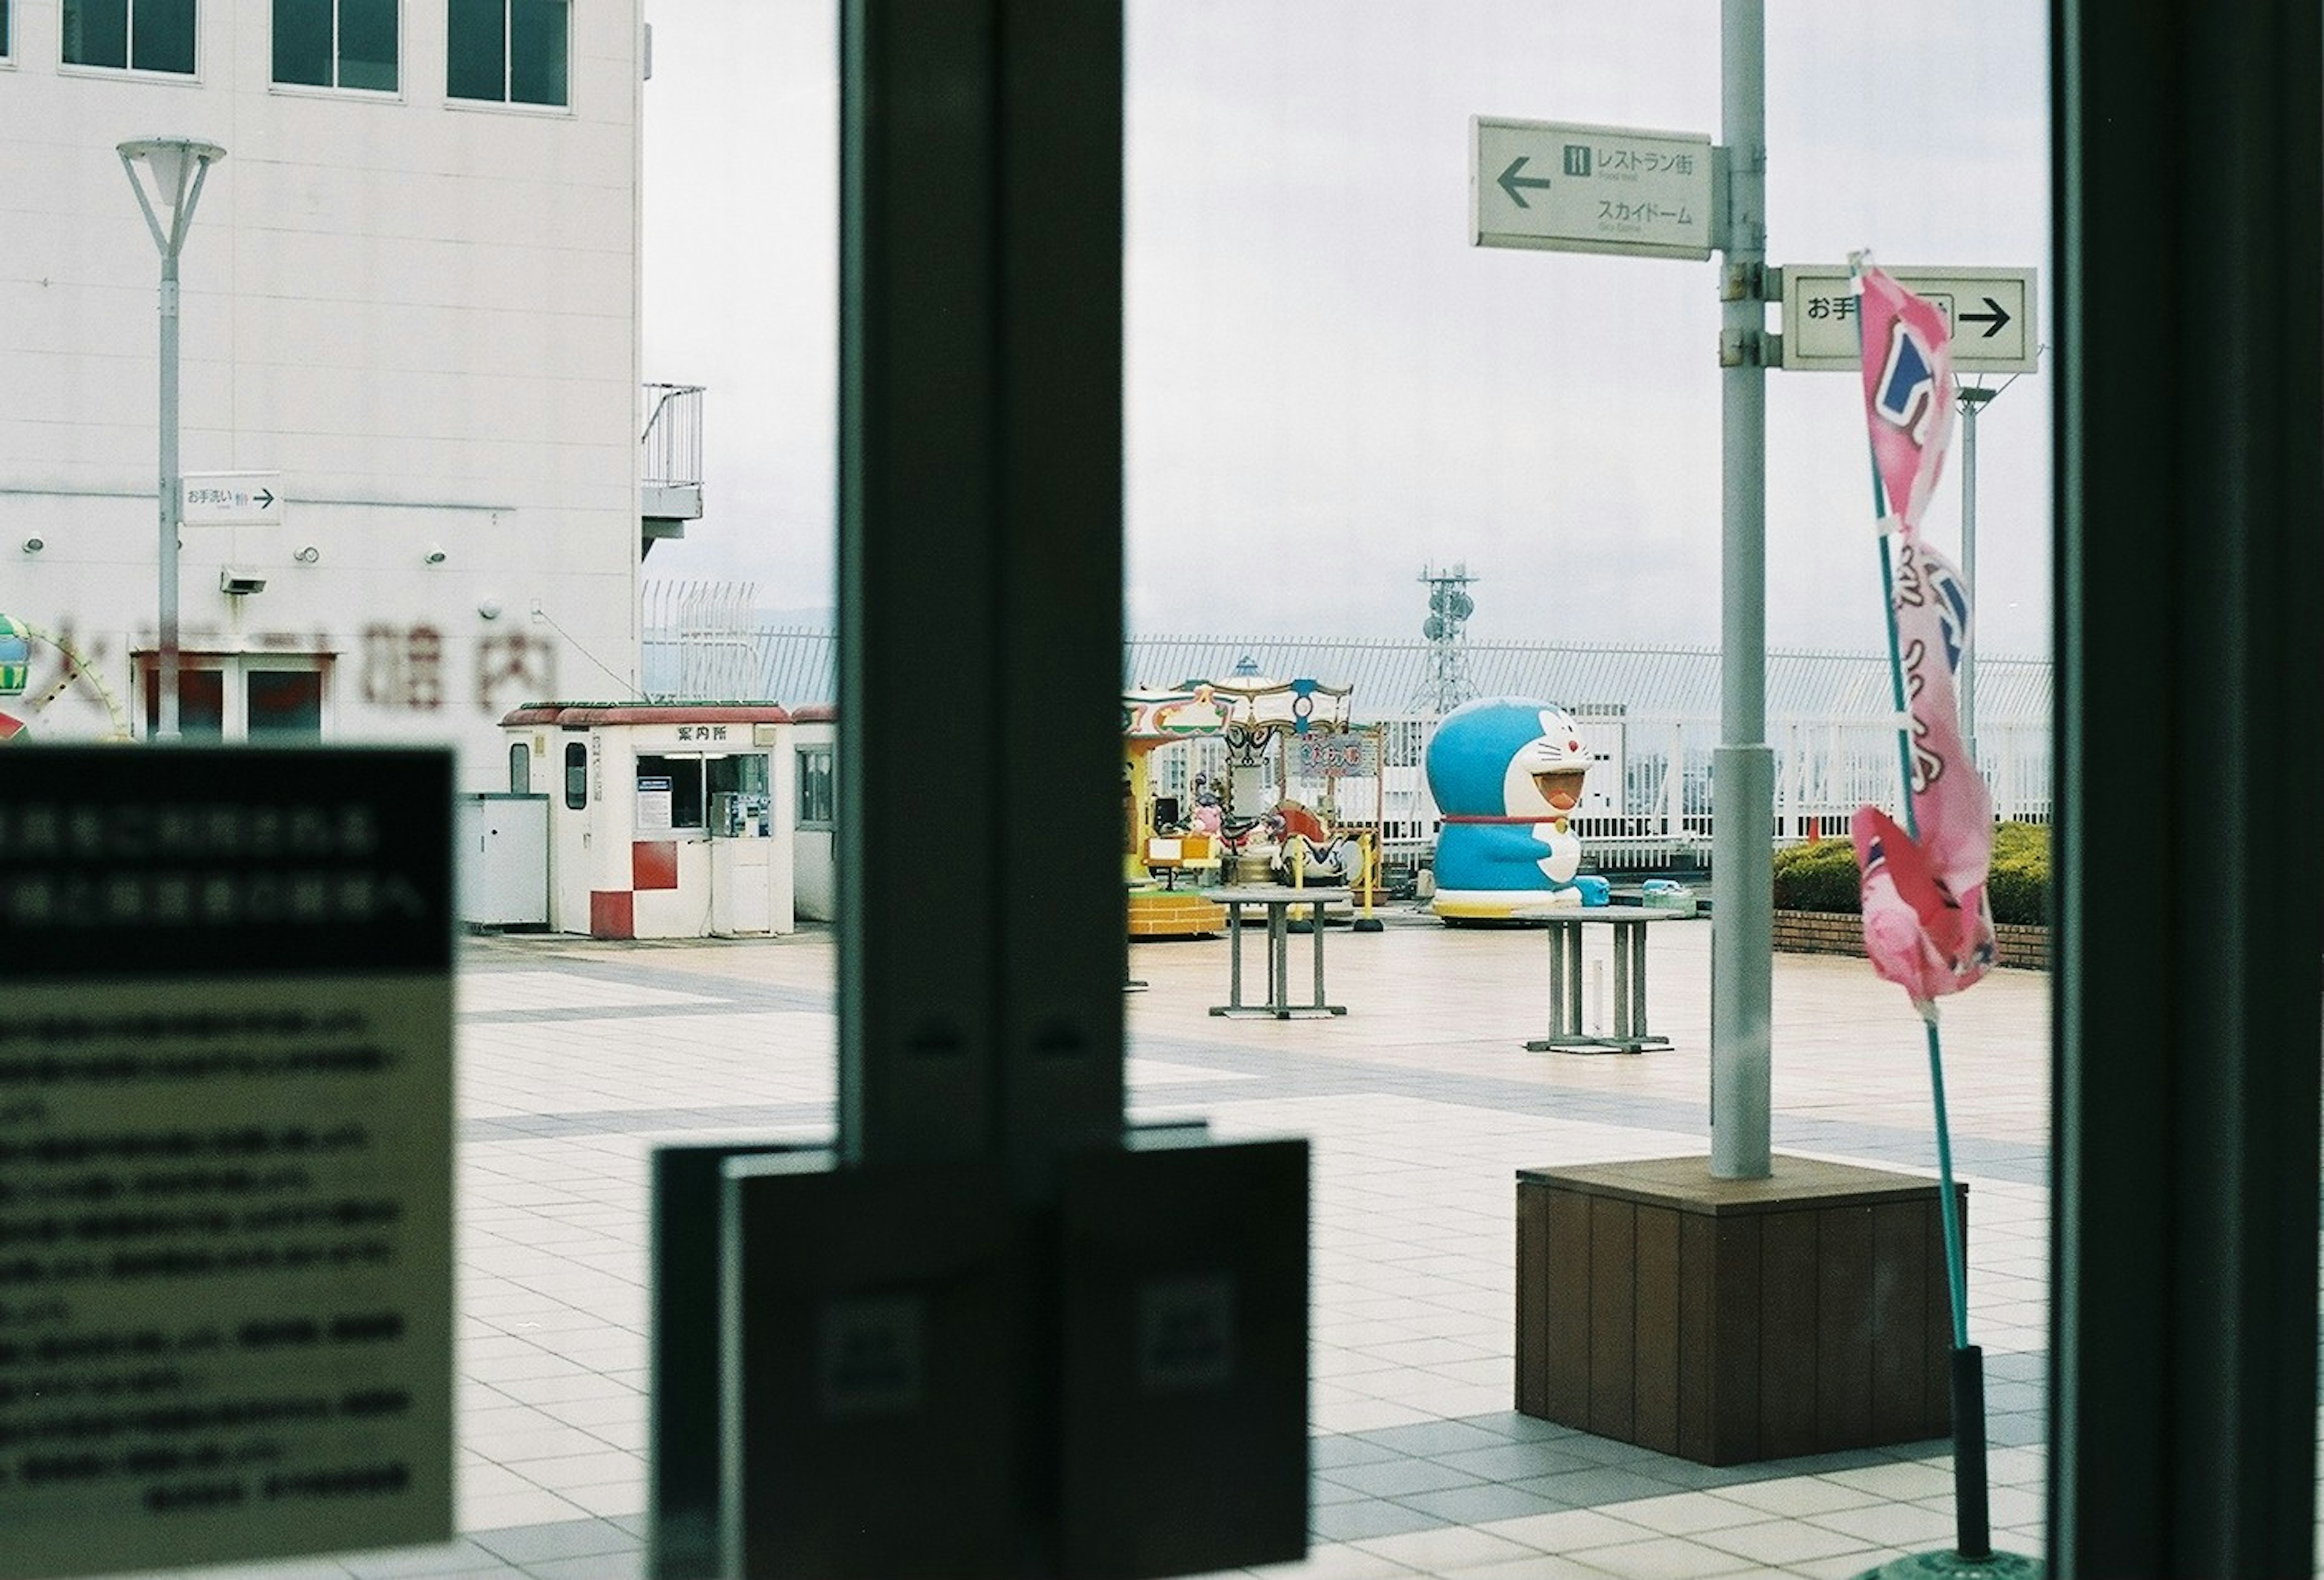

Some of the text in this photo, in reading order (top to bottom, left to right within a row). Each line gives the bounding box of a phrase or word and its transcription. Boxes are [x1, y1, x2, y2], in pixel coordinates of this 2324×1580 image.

[1598, 149, 1693, 175] レストラン街
[1598, 200, 1693, 225] スカイドーム
[1808, 297, 1855, 320] お手
[188, 489, 232, 503] お手洗い
[678, 726, 726, 741] 案内所
